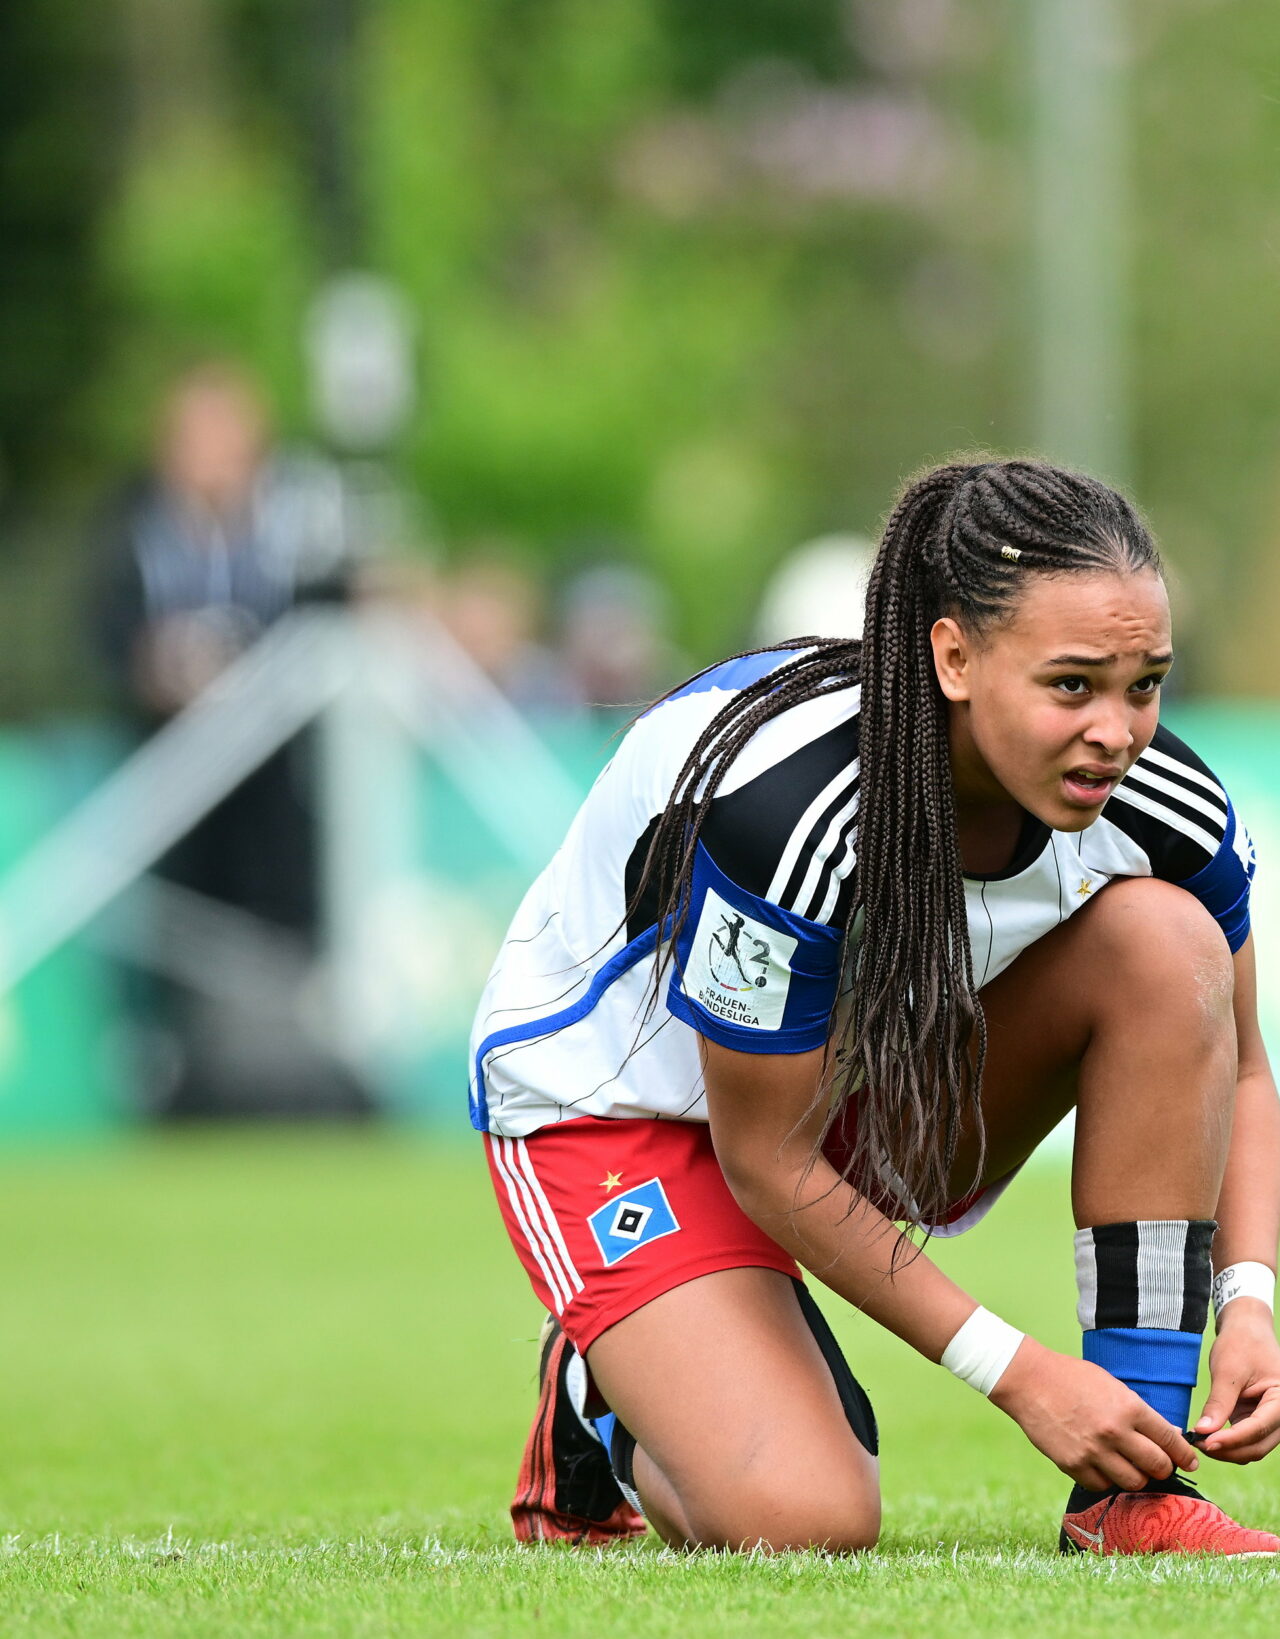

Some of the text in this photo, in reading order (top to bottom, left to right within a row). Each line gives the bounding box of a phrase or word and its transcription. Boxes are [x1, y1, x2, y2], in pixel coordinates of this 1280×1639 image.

[749, 939, 770, 966] 2
[698, 990, 760, 1026] BUNDESLIGA
[705, 986, 751, 1012] FRAUEN-
